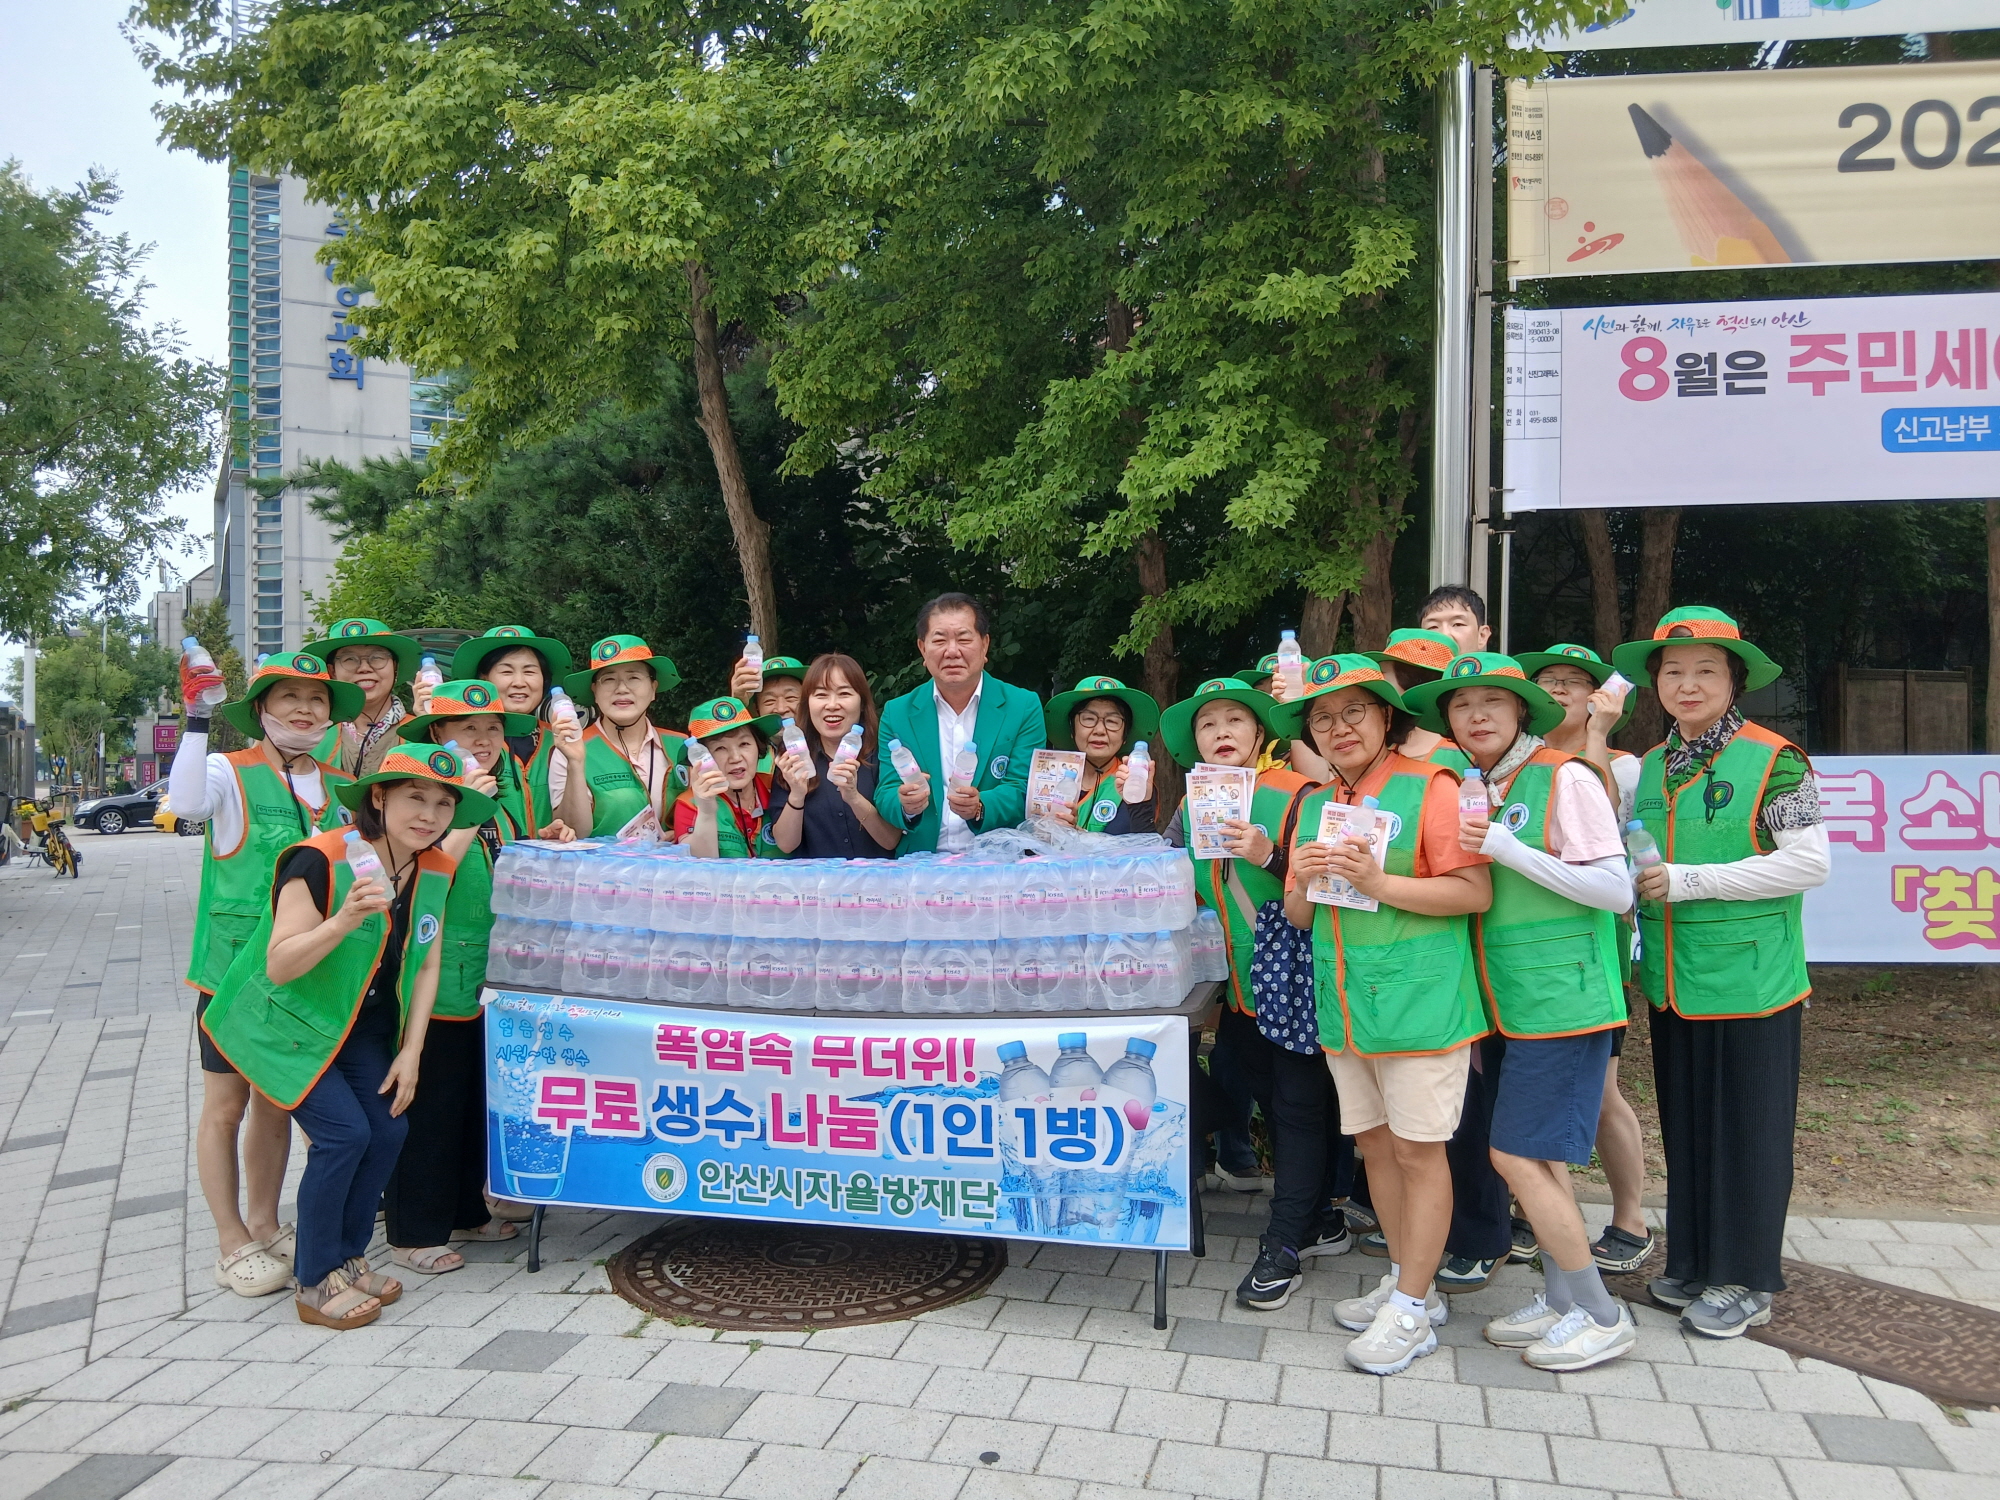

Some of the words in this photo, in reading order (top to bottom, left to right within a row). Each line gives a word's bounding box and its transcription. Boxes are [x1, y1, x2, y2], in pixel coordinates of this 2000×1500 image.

[1716, 315, 1766, 334] 혁신도시
[1771, 311, 1812, 329] 안산
[1618, 336, 1768, 402] 8월은
[1788, 327, 2000, 397] 주민세
[1893, 414, 1992, 444] 신고납부
[561, 1048, 590, 1067] 생수
[655, 1023, 793, 1076] 폭염속
[811, 1035, 977, 1084] 무더위!
[537, 1076, 642, 1132] 무료
[651, 1083, 754, 1143] 생수
[770, 1092, 880, 1151] 나눔
[889, 1099, 994, 1159] (1인
[1014, 1103, 1126, 1166] 1병)
[698, 1161, 998, 1220] 안산시자율방재단
[1620, 1255, 1643, 1270] crocs
